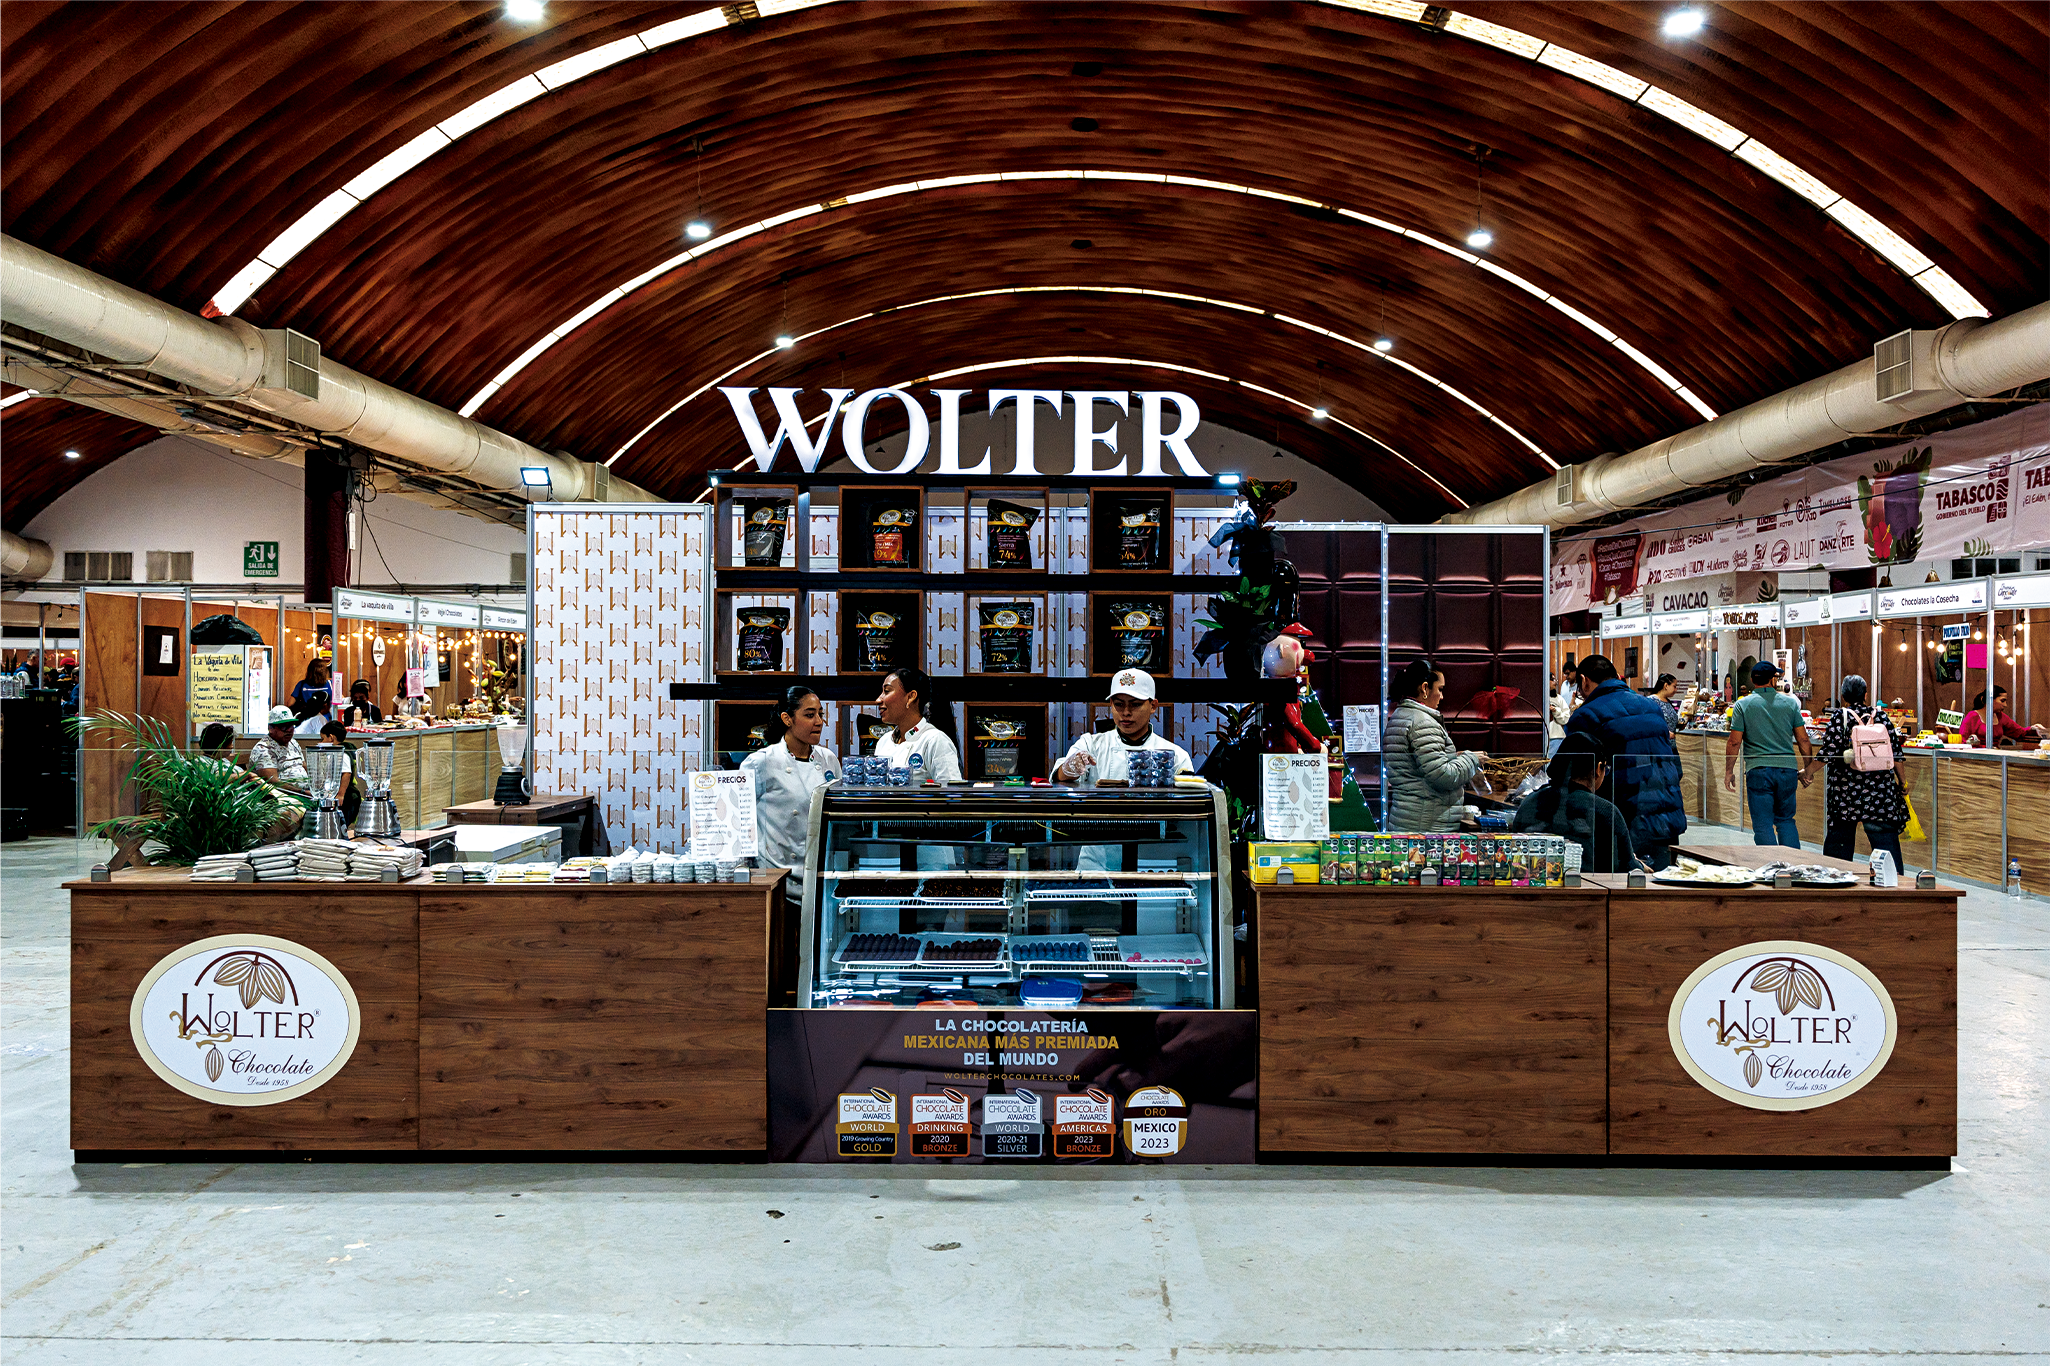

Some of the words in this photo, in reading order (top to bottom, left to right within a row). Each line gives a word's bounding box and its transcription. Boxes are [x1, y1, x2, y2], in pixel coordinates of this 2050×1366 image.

[717, 387, 1212, 477] WOLTER
[1936, 482, 1995, 511] TABASCO
[1936, 510, 1958, 520] GOBIERNO
[1959, 508, 1968, 516] DEL
[1968, 505, 1986, 515] PUEBLO
[999, 550, 1016, 559] 74%
[1663, 591, 1708, 611] CAVACAO
[1901, 597, 1929, 606] Chocolates
[1930, 596, 1935, 604] la
[1936, 594, 1959, 604] Cosecha
[744, 649, 761, 659] 80%
[991, 653, 1007, 661] 72%
[987, 764, 1006, 773] 34%
[182, 993, 314, 1039] WOLTER
[936, 1019, 956, 1031] LA
[961, 1018, 1089, 1033] CHOCOLATERÍA
[1719, 1000, 1852, 1044] WOLTER
[904, 1035, 990, 1049] MEXICANA
[995, 1033, 1030, 1049] MÁS
[1036, 1035, 1119, 1049] PREMIADA
[227, 1049, 314, 1075] Chocolate
[963, 1052, 994, 1065] DEL
[999, 1052, 1059, 1065] MUNDO
[1766, 1054, 1852, 1080] Chocolate
[944, 1072, 1080, 1081] WOLTERCHOCOLATES.COM
[247, 1077, 270, 1086] Desde
[1785, 1081, 1808, 1091] Desde
[1810, 1083, 1828, 1091] 1958
[843, 1104, 891, 1112] CHOCOLATE
[916, 1104, 964, 1112] CHOCOLATE
[988, 1105, 1036, 1113] CHOCOLATE
[1060, 1105, 1107, 1113] CHOCOLATE
[1144, 1108, 1167, 1116] ORO
[850, 1123, 885, 1131] WORLD
[917, 1123, 964, 1132] DRINKING
[995, 1124, 1030, 1132] WORLD
[1134, 1123, 1176, 1132] MEXICO
[930, 1135, 950, 1143] 2020
[997, 1135, 1027, 1143] 2020-21
[1140, 1138, 1169, 1148] 2023
[854, 1143, 881, 1152] GOLD
[922, 1144, 958, 1152] BRONZE
[997, 1144, 1028, 1152] SILVER
